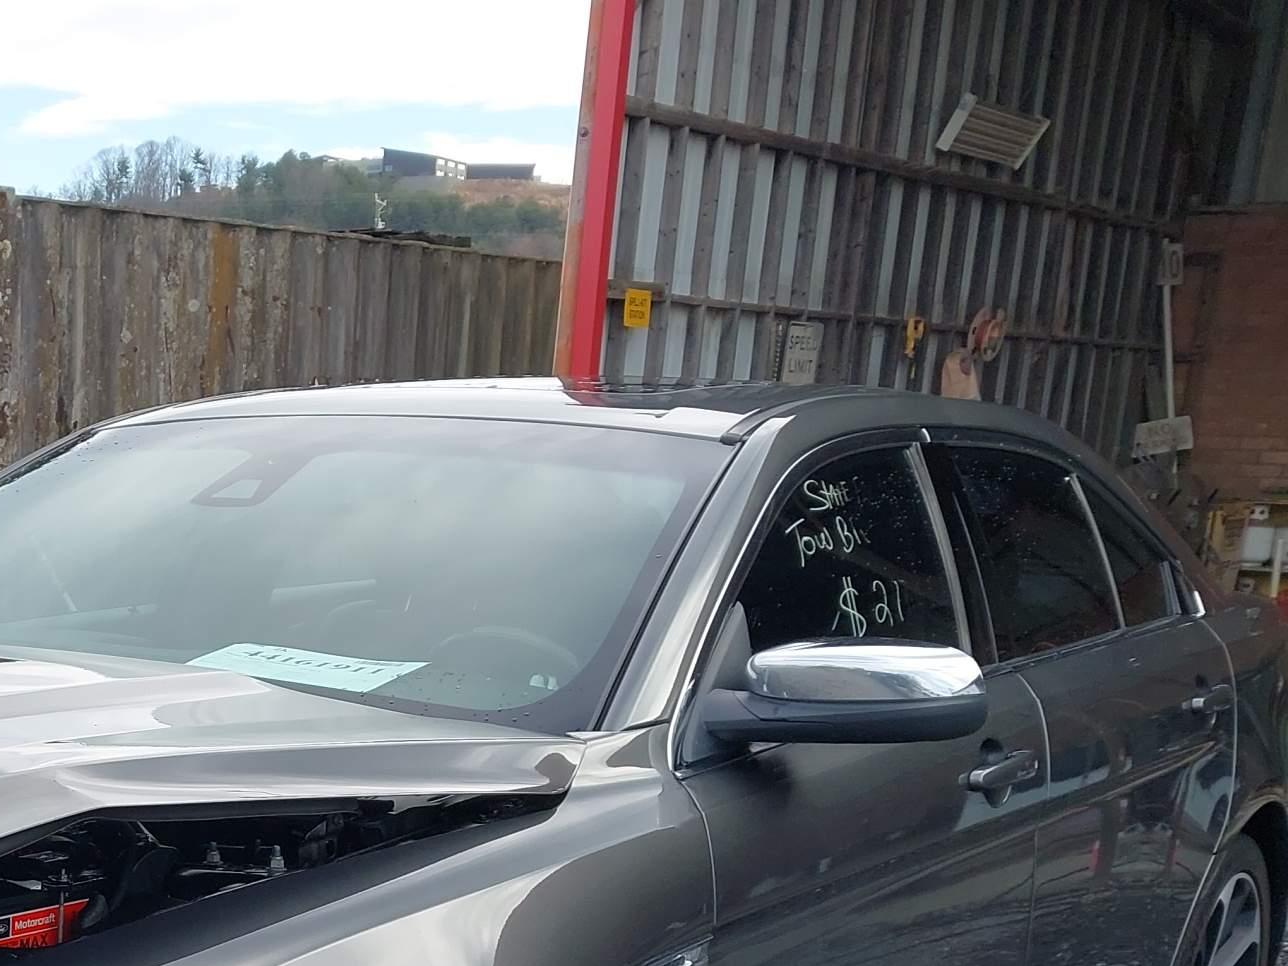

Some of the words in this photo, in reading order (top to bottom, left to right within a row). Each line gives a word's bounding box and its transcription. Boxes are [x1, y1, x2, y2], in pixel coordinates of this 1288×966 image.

[789, 335, 817, 351] SPEED
[788, 357, 814, 374] LIMIT
[243, 650, 385, 676] 44161911
[14, 912, 56, 931] Motorcraft
